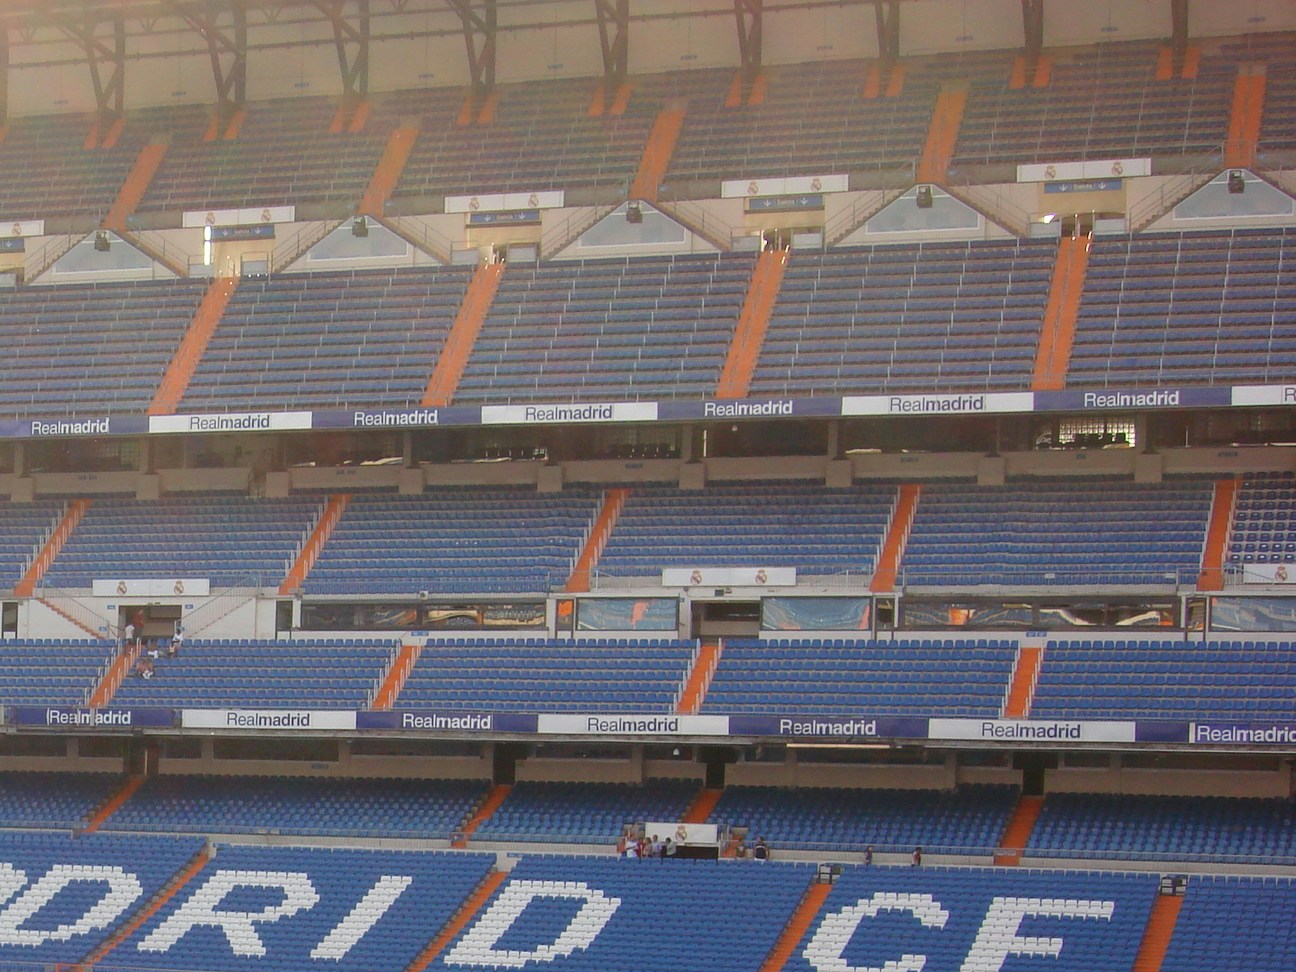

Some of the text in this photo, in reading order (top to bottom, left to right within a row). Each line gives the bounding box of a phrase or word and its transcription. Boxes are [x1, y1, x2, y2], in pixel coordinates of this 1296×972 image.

[889, 396, 984, 412] Realmadrid
[1084, 391, 1180, 408] Realmadrid
[525, 405, 613, 421] Realmadrid
[704, 401, 793, 417] Realmadrid
[189, 415, 270, 431] Realmadrid
[353, 410, 439, 426] Realmadrid
[31, 420, 108, 436] Realmadrid
[226, 712, 311, 727] Realmadrid
[402, 713, 492, 729] Realmadrid
[587, 717, 679, 733] Realmadrid
[779, 719, 877, 736] Realmadrid
[981, 722, 1081, 739] Realmadrid
